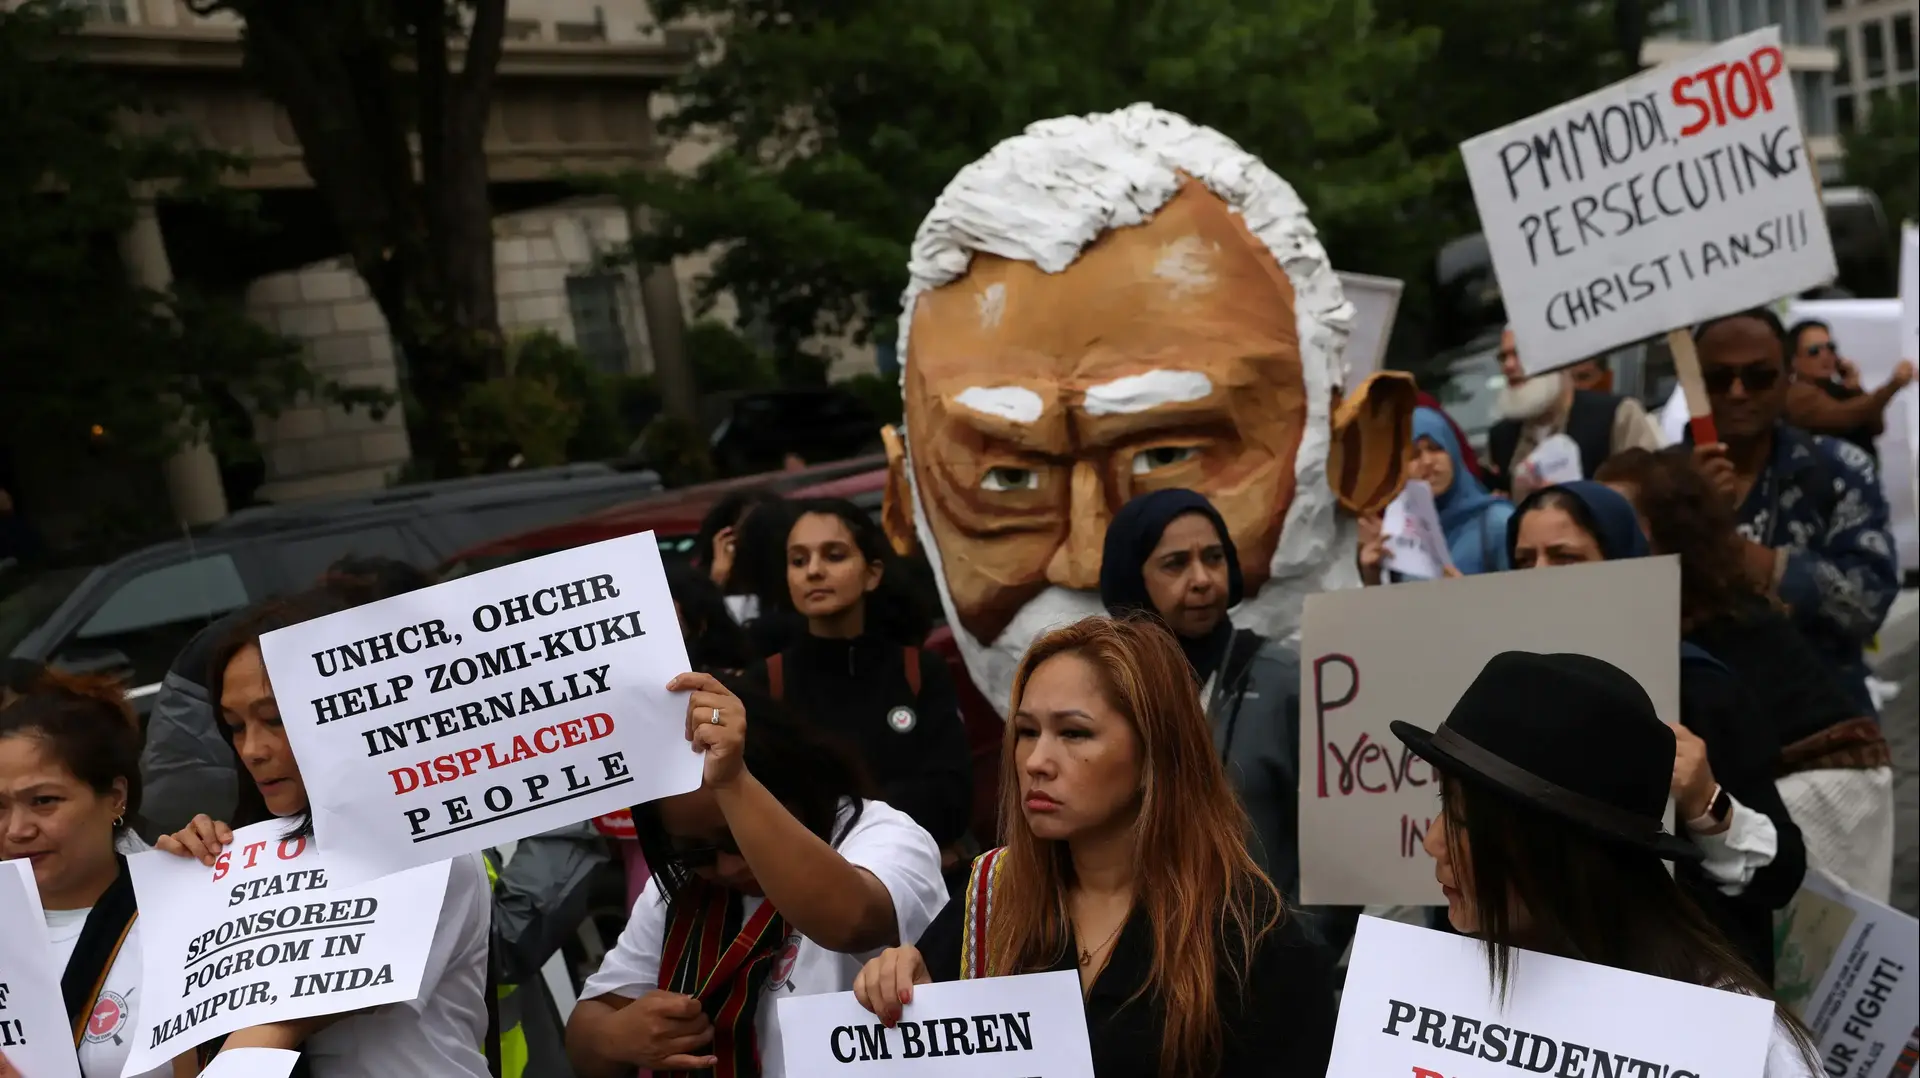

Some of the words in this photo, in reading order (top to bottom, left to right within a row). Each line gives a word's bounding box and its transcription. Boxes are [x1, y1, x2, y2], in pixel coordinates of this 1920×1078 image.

[1671, 47, 1783, 137] STOP
[1518, 125, 1801, 266] PERSECUTING
[310, 674, 414, 726] HELP
[424, 610, 646, 694] ZOMI-KUKI
[311, 618, 463, 678] UNHCR,
[472, 574, 620, 633] OHCHR
[361, 663, 611, 758] INTERNALLY
[387, 712, 615, 796] DISPLACED
[1313, 653, 1440, 798] Preve
[403, 751, 631, 836] PEOPLE
[212, 834, 308, 883] STO
[228, 868, 329, 908] STATE
[181, 938, 314, 998] POGROM
[320, 932, 366, 959] IN
[186, 897, 378, 963] SPONSORED
[149, 981, 278, 1050] MANIPUR,
[290, 963, 394, 998] INIDA
[831, 1022, 893, 1064] CM
[897, 1011, 1033, 1059] BIREN
[1823, 1042, 1859, 1078] UR
[1842, 956, 1905, 1041] FIGHT!
